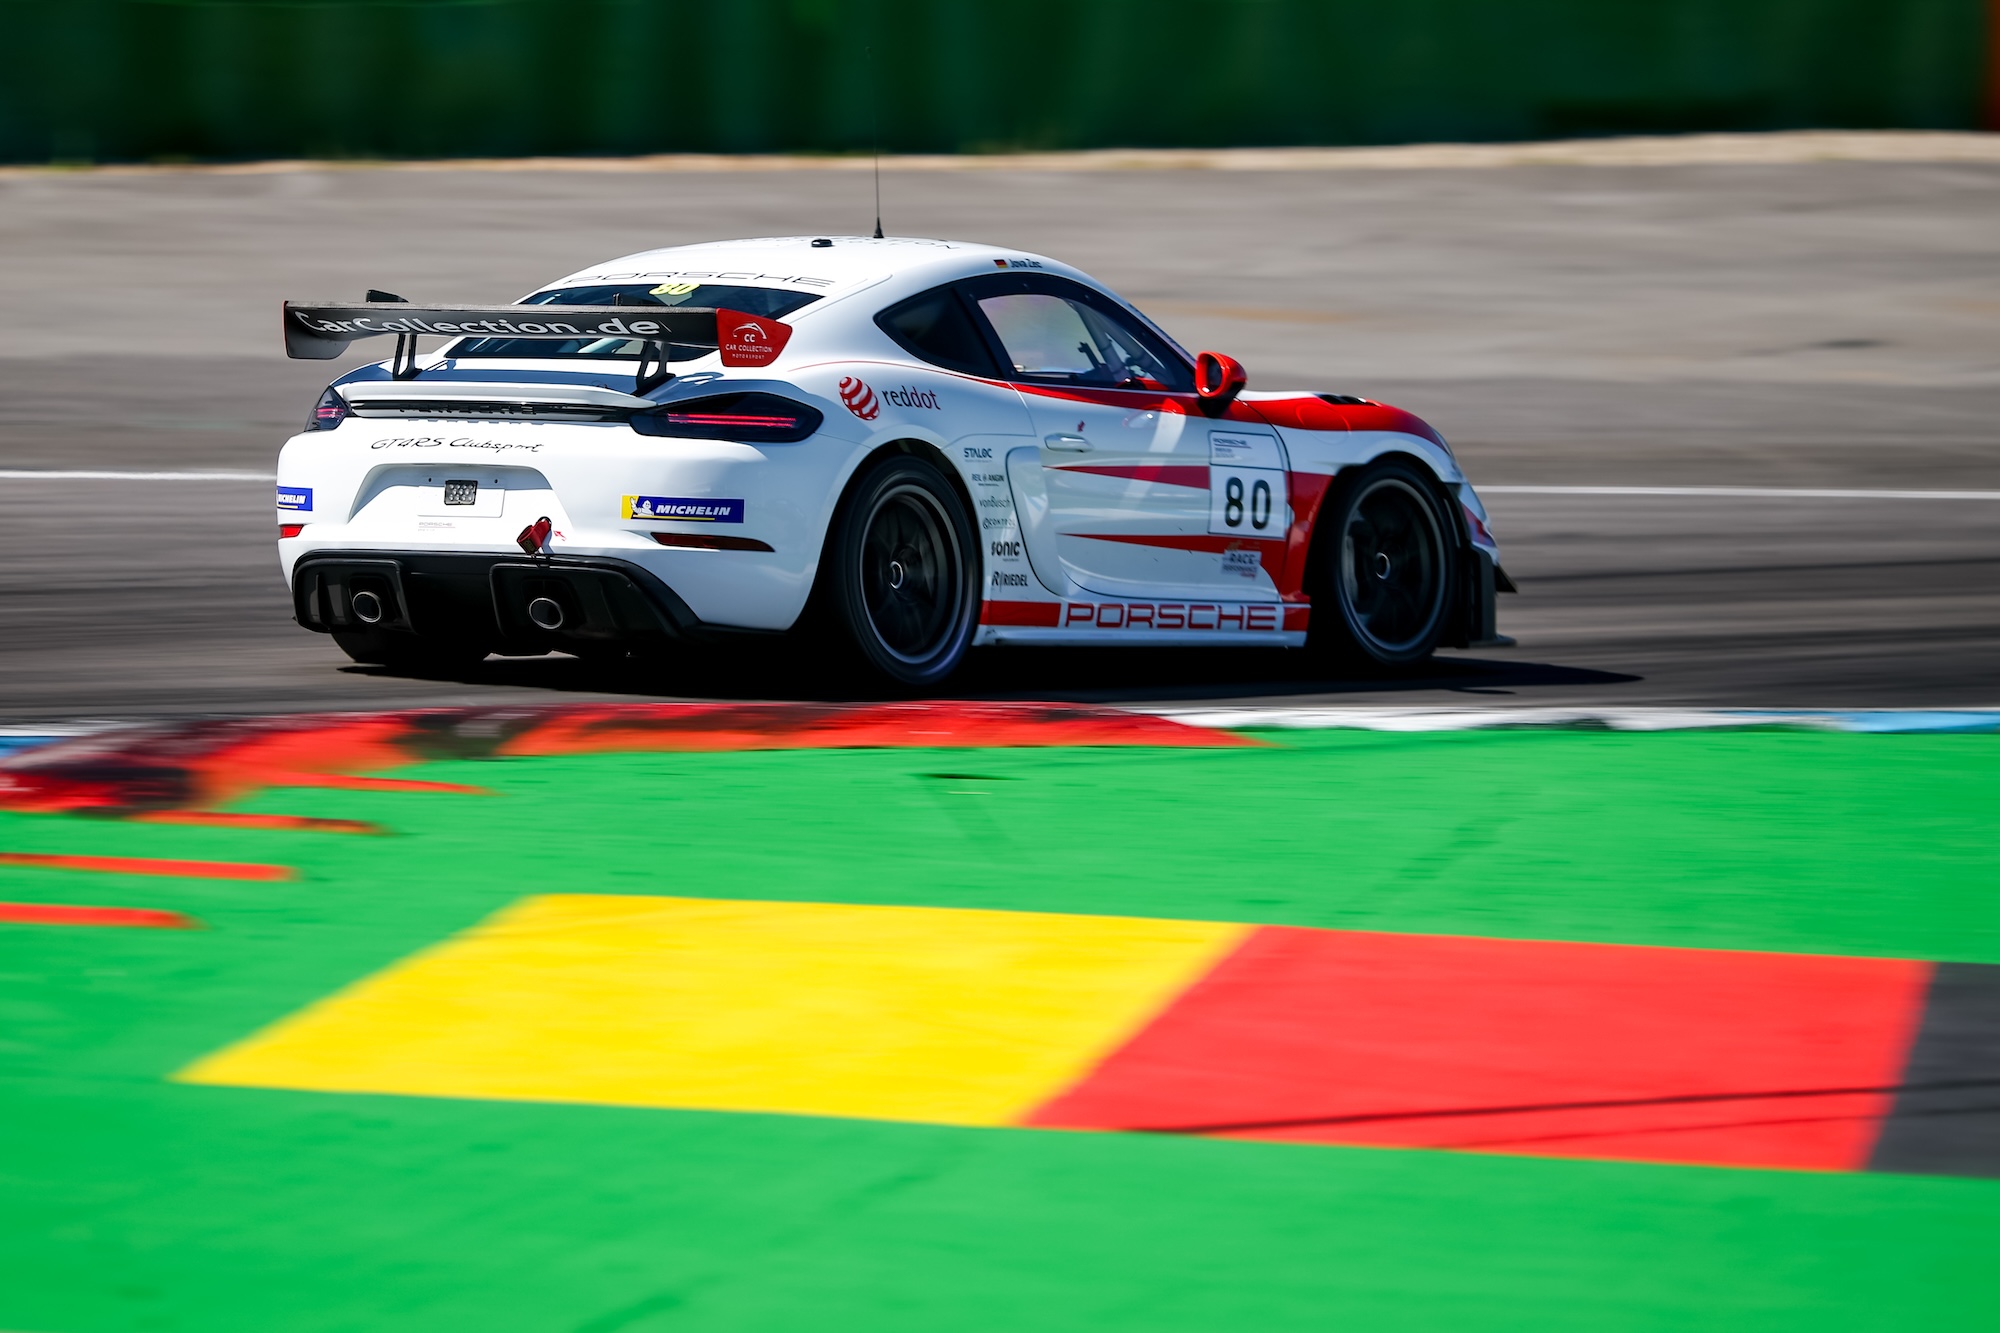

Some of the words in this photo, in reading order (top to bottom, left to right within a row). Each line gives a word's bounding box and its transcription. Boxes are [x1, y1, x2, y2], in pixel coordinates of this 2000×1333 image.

[563, 271, 836, 288] PORSCHE
[649, 283, 700, 296] 80
[295, 310, 661, 336] CarCollection.de
[744, 333, 756, 342] CC
[882, 385, 941, 410] reddot
[655, 505, 731, 516] MICHELIN
[1225, 476, 1271, 530] 80
[1065, 602, 1277, 631] PORSCHE
